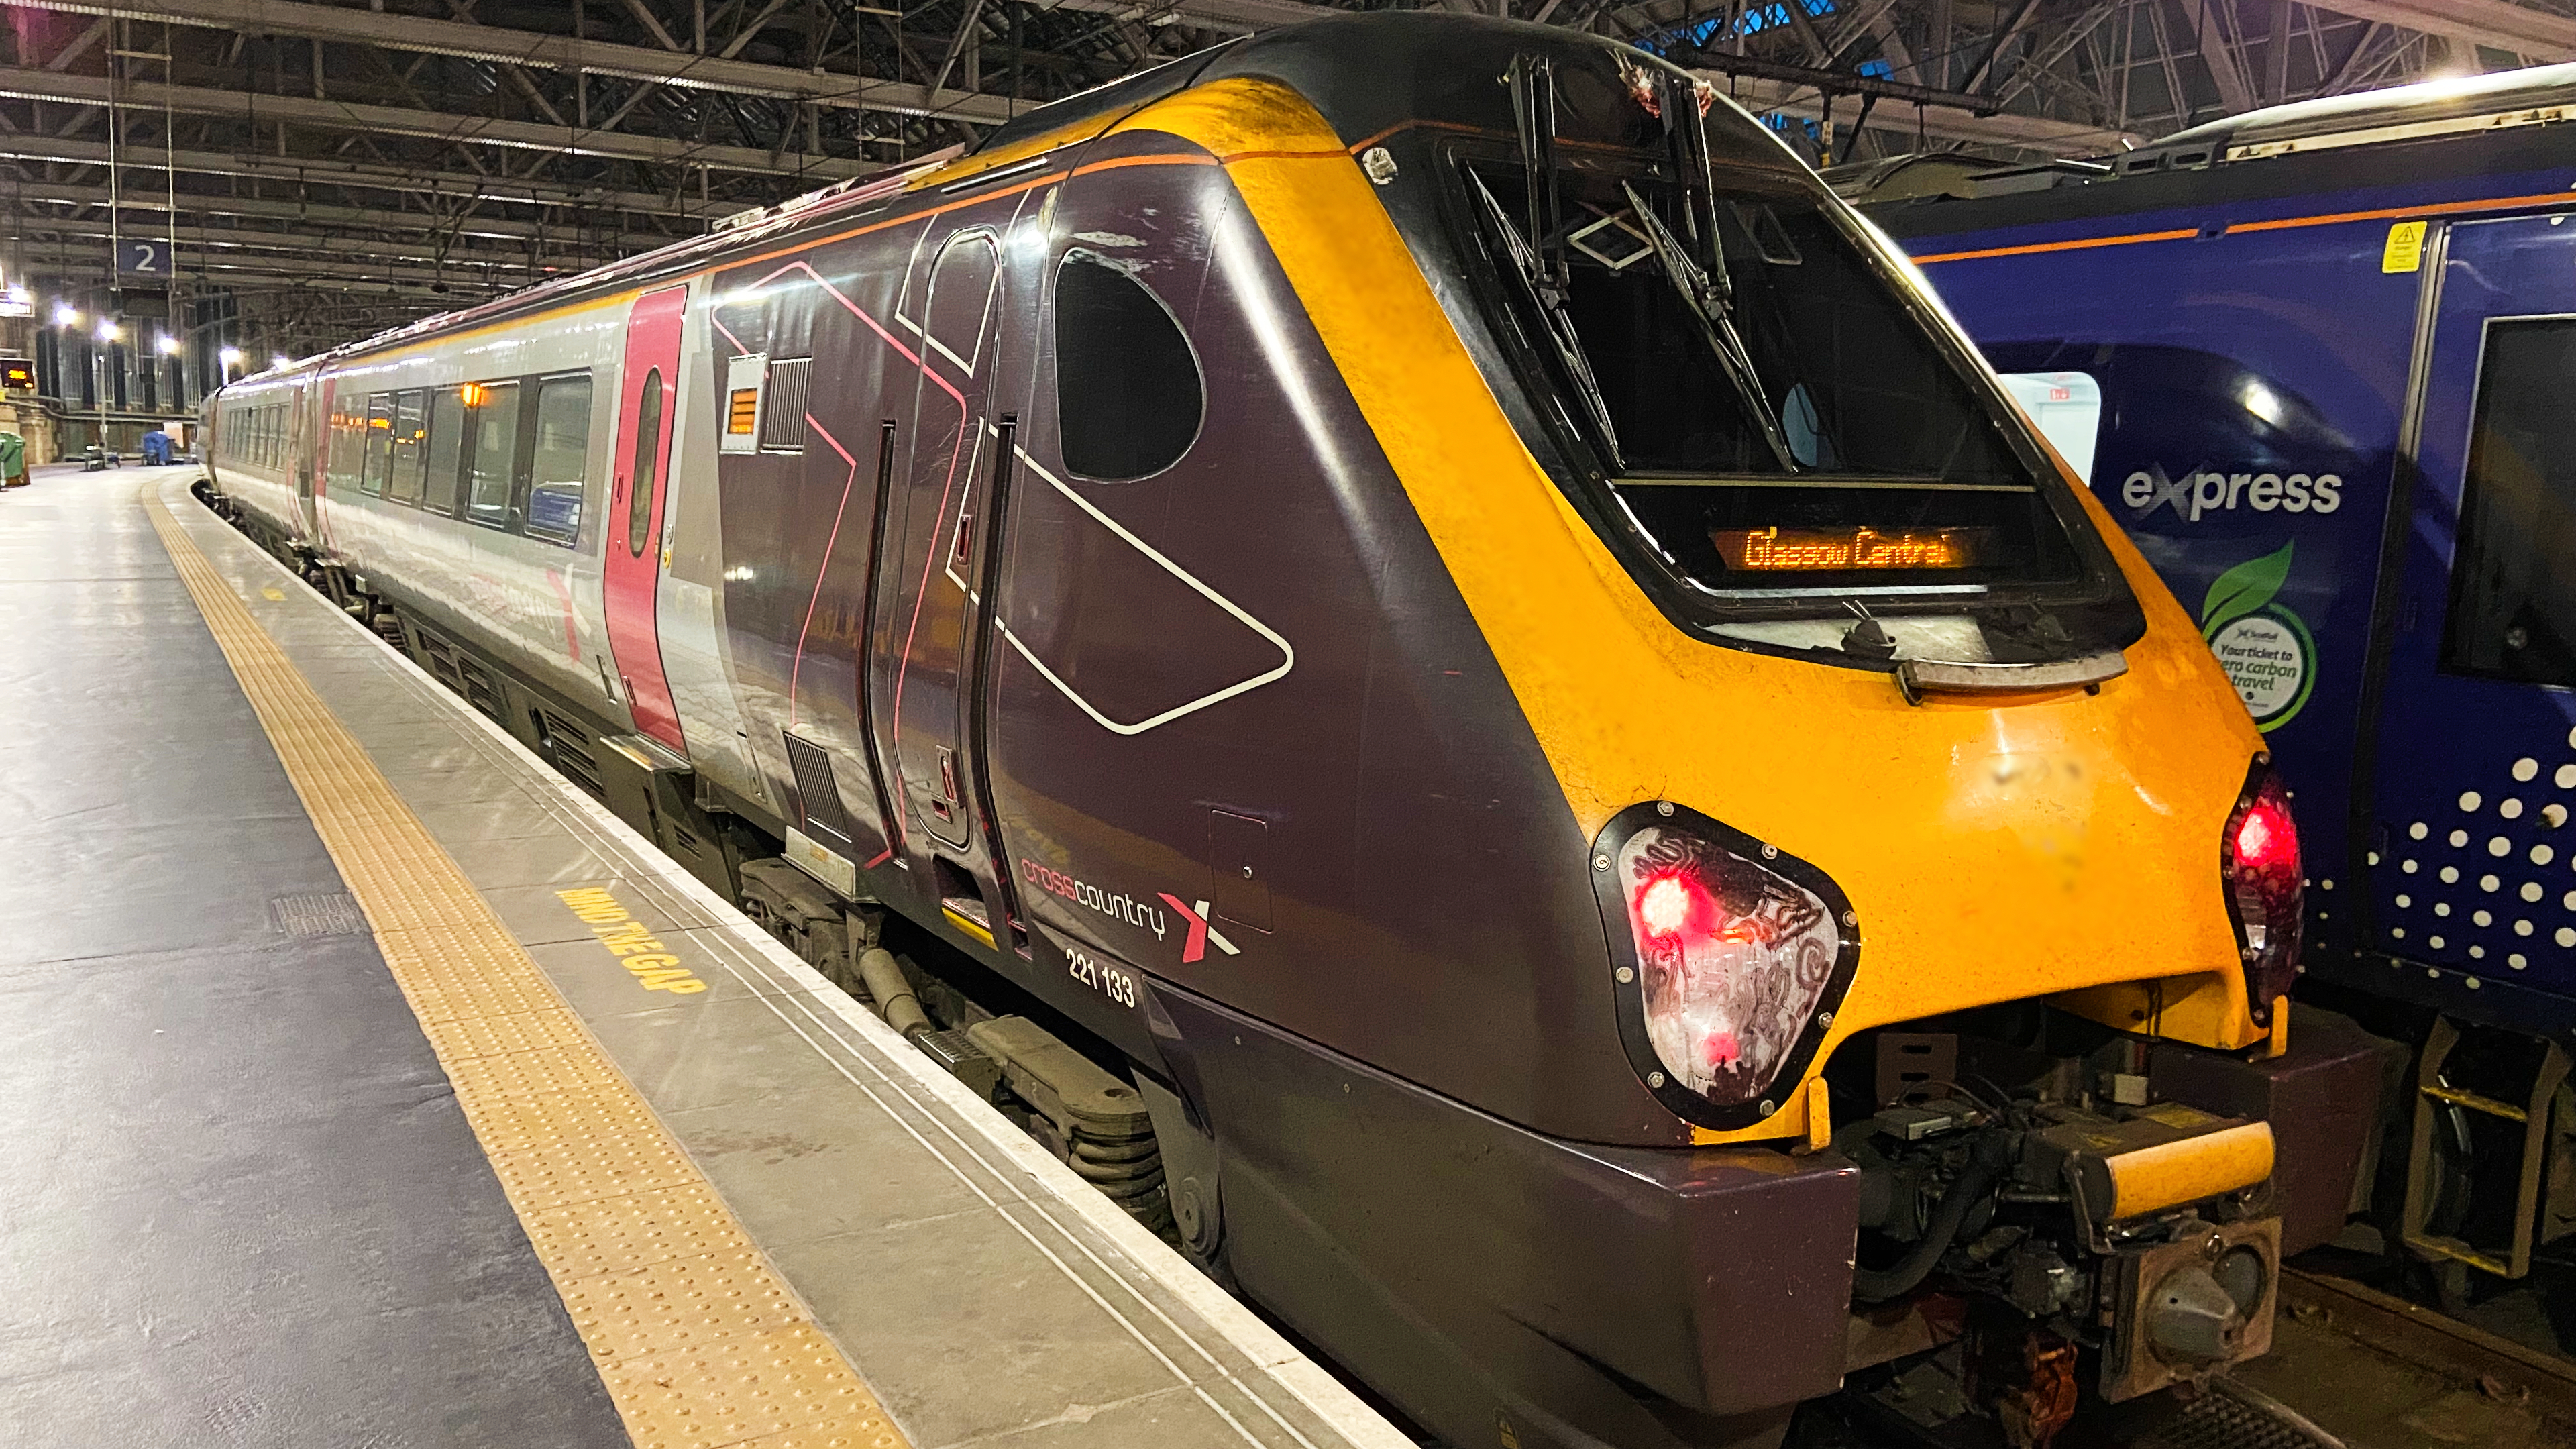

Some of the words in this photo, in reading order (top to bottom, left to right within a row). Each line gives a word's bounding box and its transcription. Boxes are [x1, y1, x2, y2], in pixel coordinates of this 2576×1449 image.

[134, 244, 156, 272] 2
[2123, 464, 2343, 522] express
[2221, 644, 2245, 656] Your
[2247, 647, 2279, 660] ticket
[2281, 651, 2293, 661] to
[2221, 660, 2243, 672] ero
[2246, 661, 2297, 678] carbon
[2231, 674, 2275, 690] travel
[555, 887, 629, 924] MIND
[1022, 858, 1165, 941] crosscountry
[592, 922, 665, 956] THE
[621, 953, 708, 994] GAP
[1065, 948, 1098, 990] 221
[1101, 965, 1135, 1008] 133
